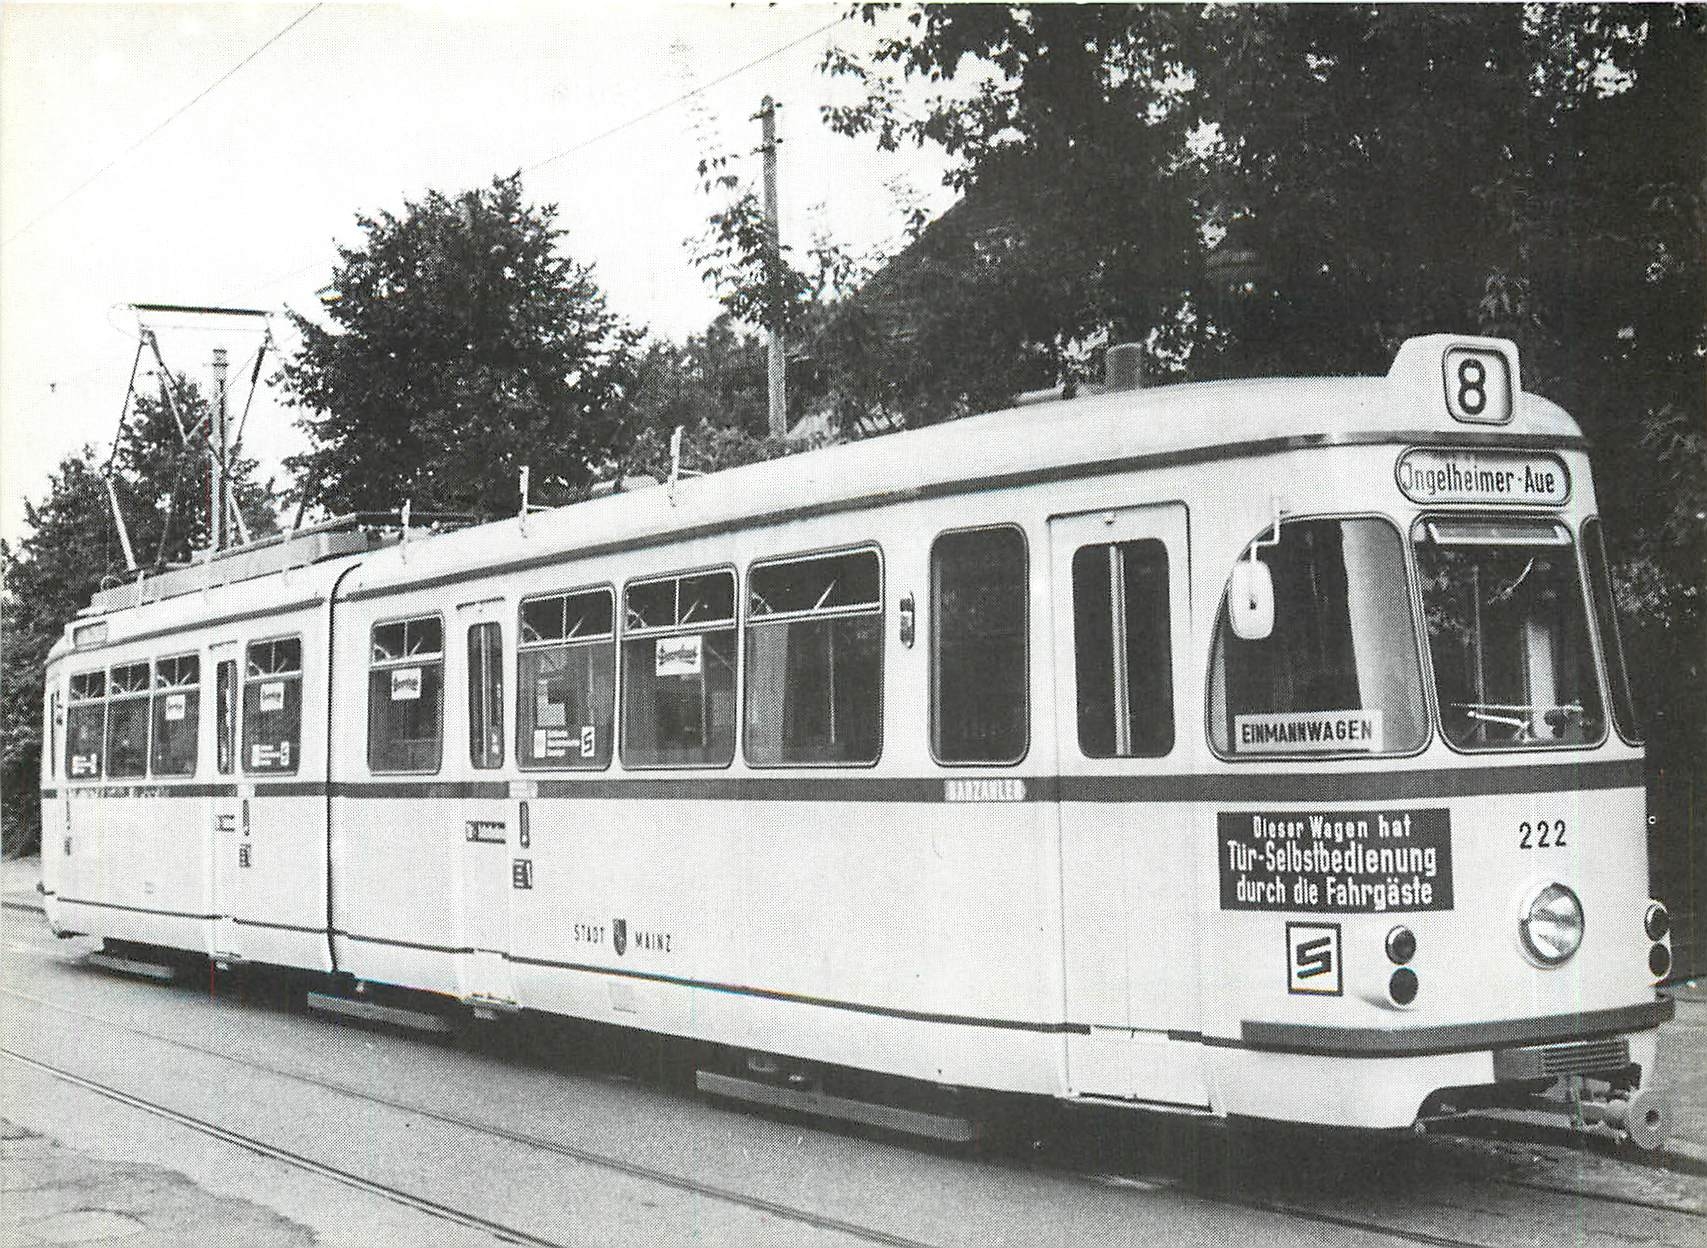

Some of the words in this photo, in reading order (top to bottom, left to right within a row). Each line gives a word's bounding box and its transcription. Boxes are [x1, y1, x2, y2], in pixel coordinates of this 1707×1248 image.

[1457, 358, 1487, 416] 8
[1241, 719, 1373, 744] EINMANNWAGEN
[1253, 815, 1304, 839] Dieser
[1309, 815, 1369, 843] Wagen
[1378, 813, 1412, 838] hat
[1519, 819, 1567, 850] 222
[1226, 839, 1437, 877] Tür-Selbstbedienung
[1236, 873, 1286, 903] durch
[1293, 875, 1319, 905] die
[1326, 875, 1433, 911] Fahrgäste
[573, 924, 605, 944] STADT
[634, 930, 671, 953] MAINZ
